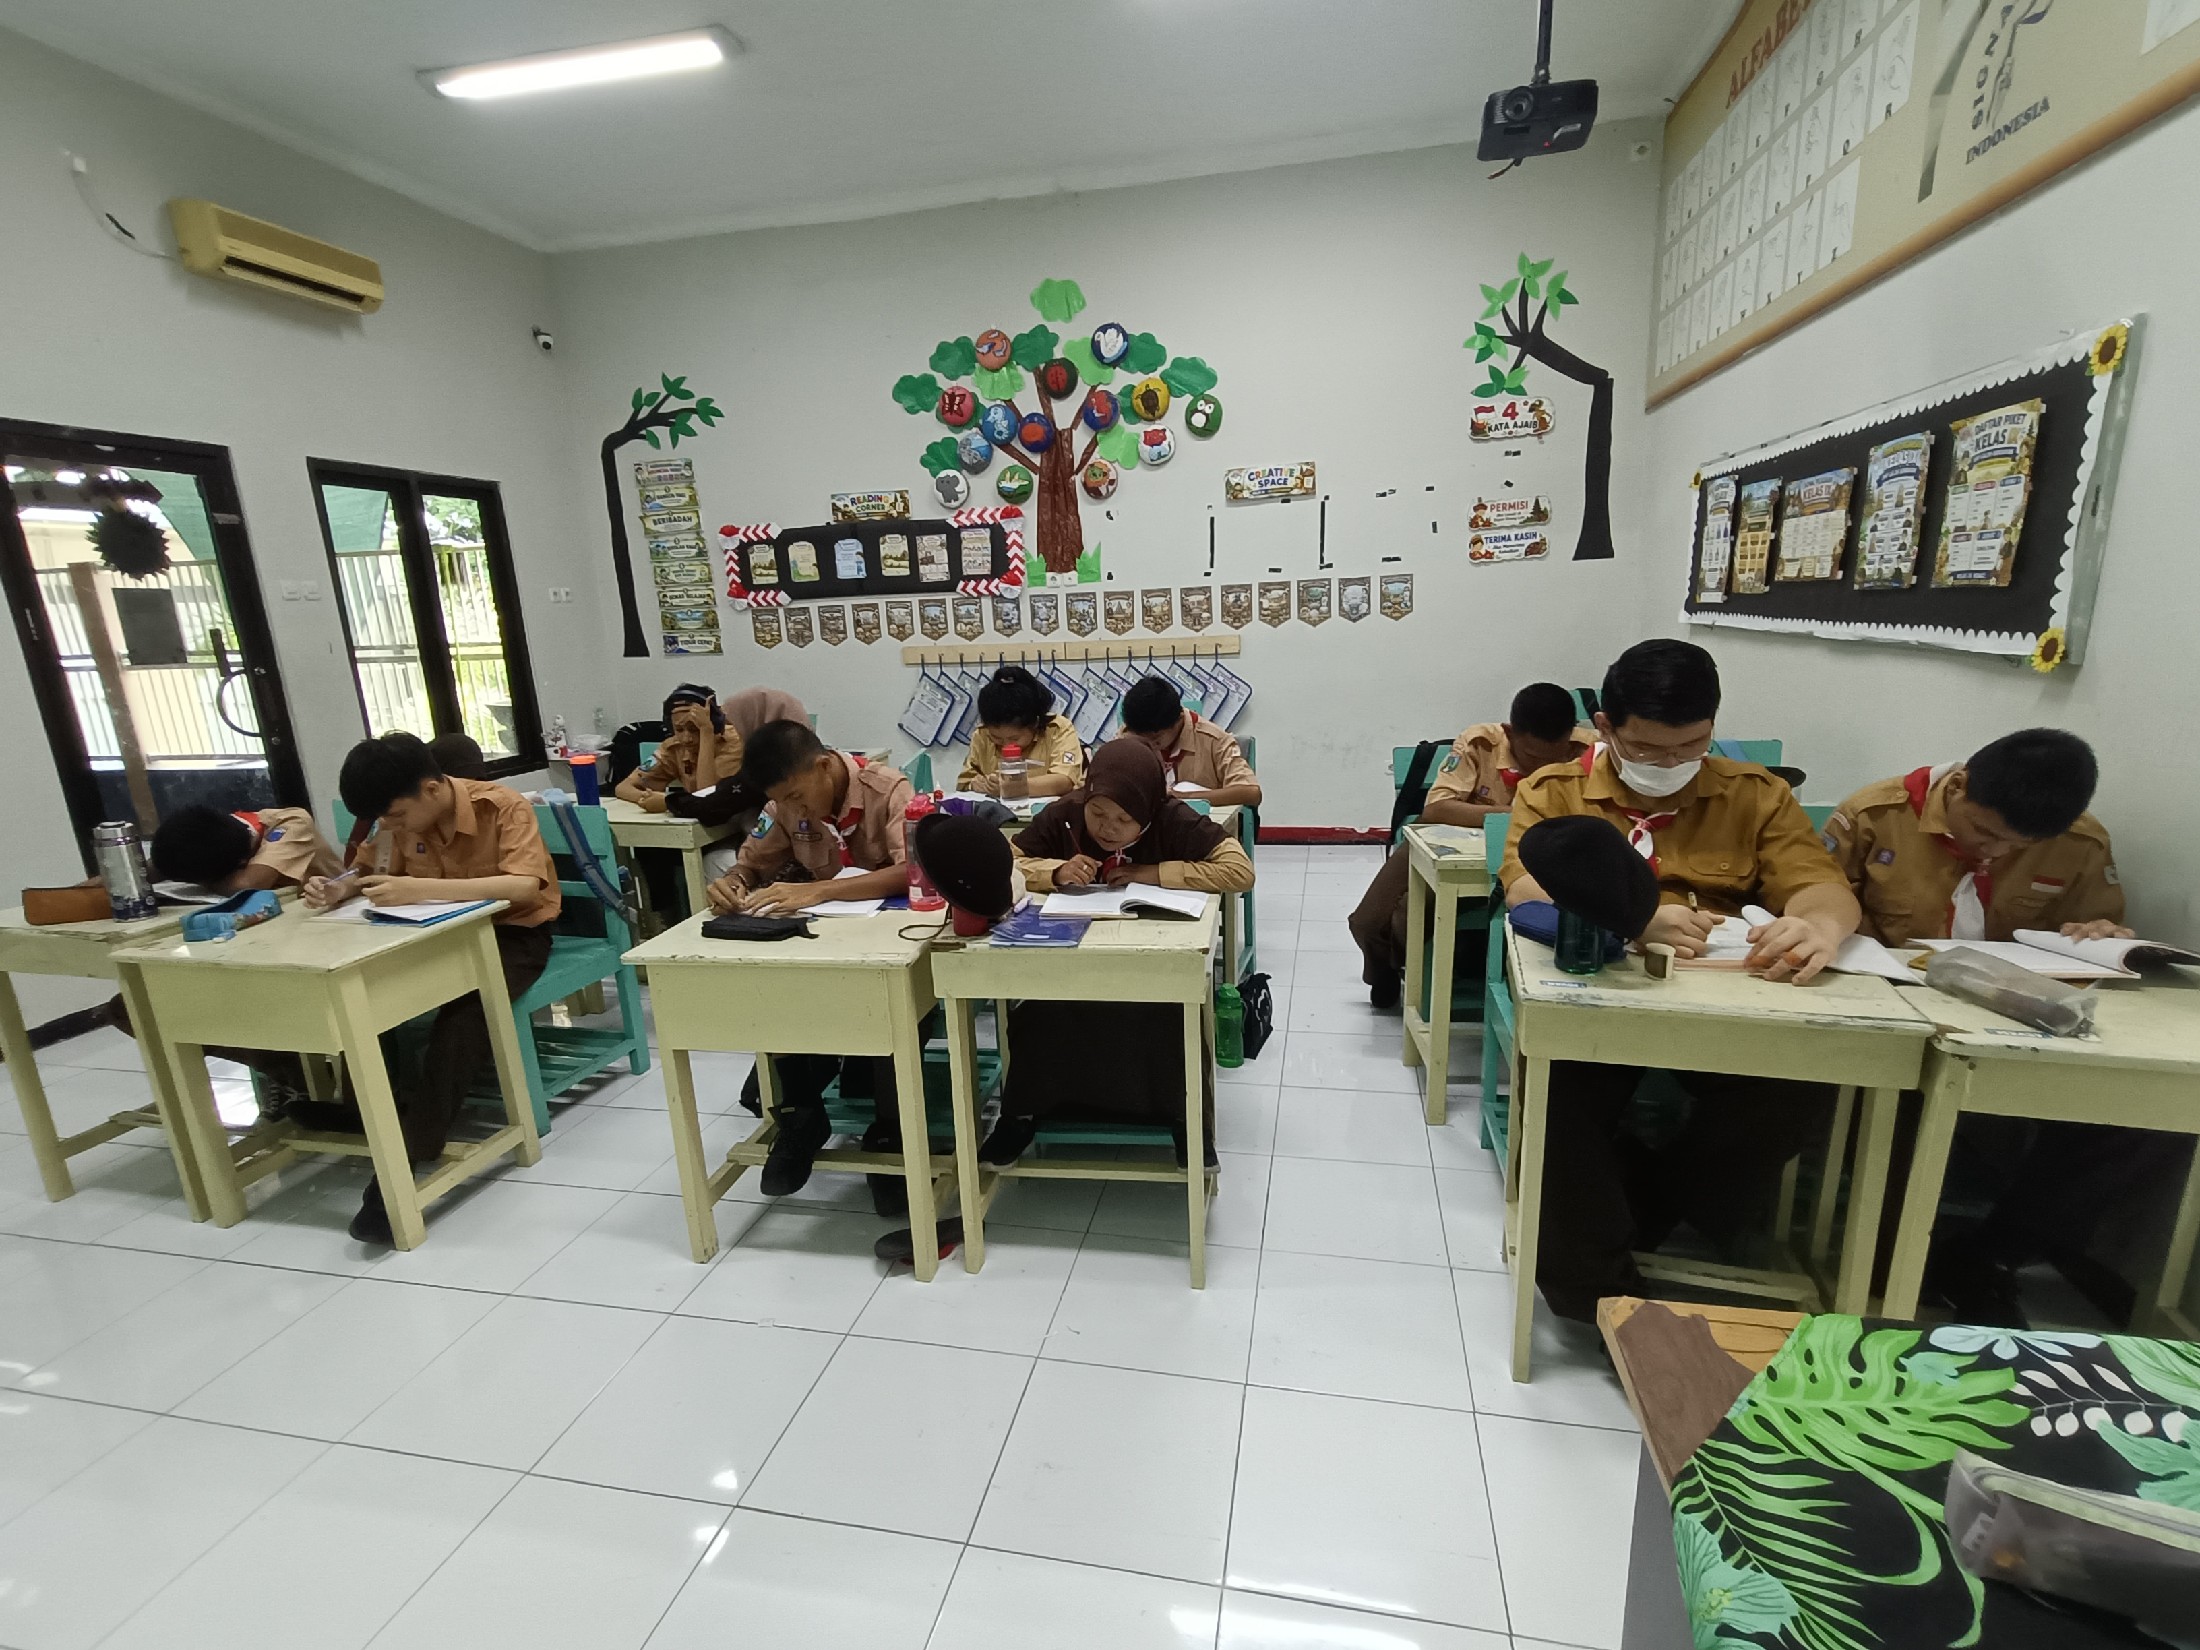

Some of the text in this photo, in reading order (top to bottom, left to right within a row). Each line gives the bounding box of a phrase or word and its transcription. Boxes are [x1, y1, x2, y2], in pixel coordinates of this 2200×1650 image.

[1966, 96, 2050, 165] INDONESIA
[1502, 401, 1520, 421] 4
[1488, 420, 1538, 434] KATA AJAIB
[1975, 412, 2028, 436] DAFTAR PIKET
[1974, 428, 2008, 452] KELAS
[1247, 467, 1296, 482] CREATIVE
[1258, 477, 1289, 488] SPACE
[849, 494, 890, 507] READING
[1489, 501, 1529, 513] PERMISI
[855, 503, 886, 513] CORNER
[652, 515, 693, 527] BERIBADAH
[1484, 531, 1538, 545] TERIMA KASIH
